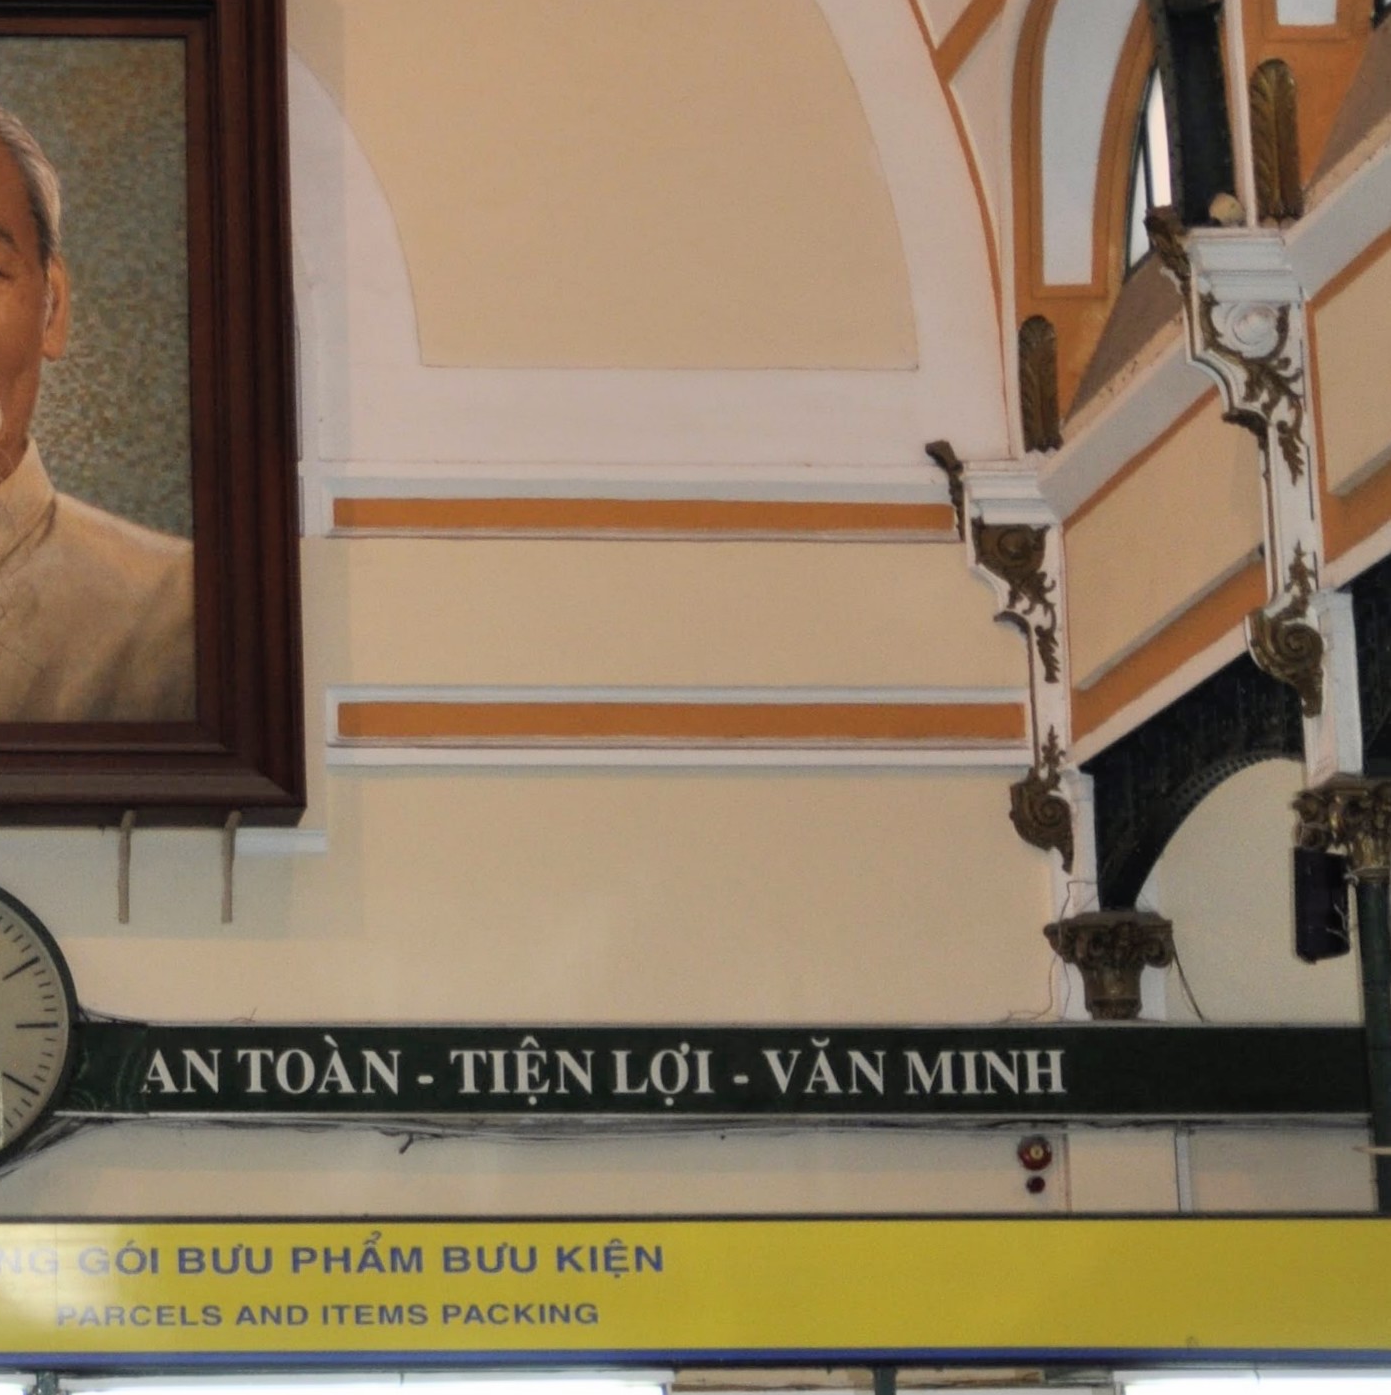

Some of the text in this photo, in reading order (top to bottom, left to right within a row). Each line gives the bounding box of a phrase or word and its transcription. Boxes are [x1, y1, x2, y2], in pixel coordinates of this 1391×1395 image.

[142, 1048, 222, 1094] AN
[237, 1034, 401, 1094] TOÀN
[450, 1035, 593, 1106] TIỆN
[613, 1042, 713, 1106] LỢI
[763, 1038, 885, 1095] VĂN
[906, 1050, 1067, 1094] MINH
[77, 1238, 160, 1276] GÓI
[176, 1243, 273, 1275] BƯU
[290, 1231, 423, 1275] PHẨM
[441, 1243, 537, 1274] BƯU
[556, 1238, 664, 1278] KIỆN
[56, 1303, 600, 1328] PARCELS AND ITEMS PACKING
